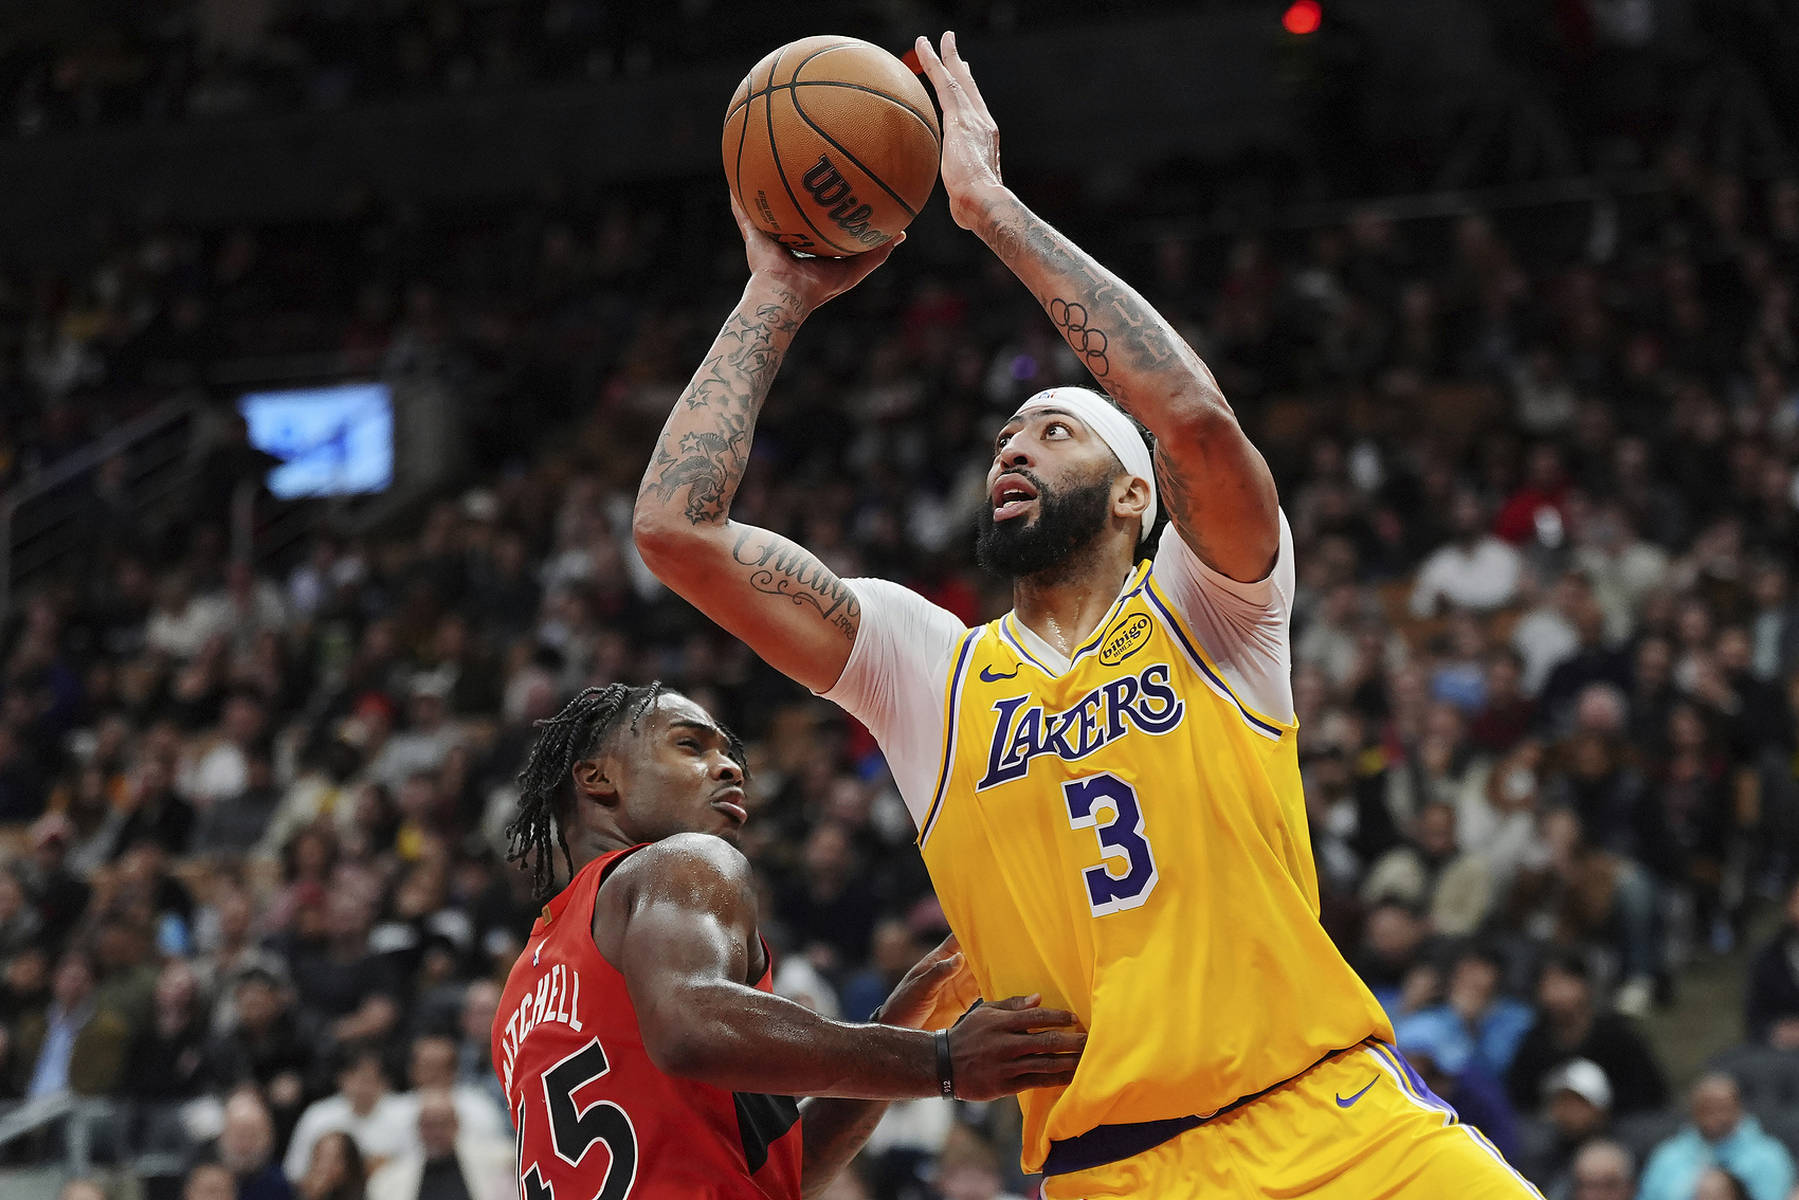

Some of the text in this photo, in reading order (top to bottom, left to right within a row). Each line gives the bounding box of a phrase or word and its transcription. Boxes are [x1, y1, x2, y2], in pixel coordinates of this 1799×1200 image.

[1102, 618, 1148, 660] bibigo
[975, 663, 1186, 794] LAKERS
[1060, 770, 1160, 919] 3
